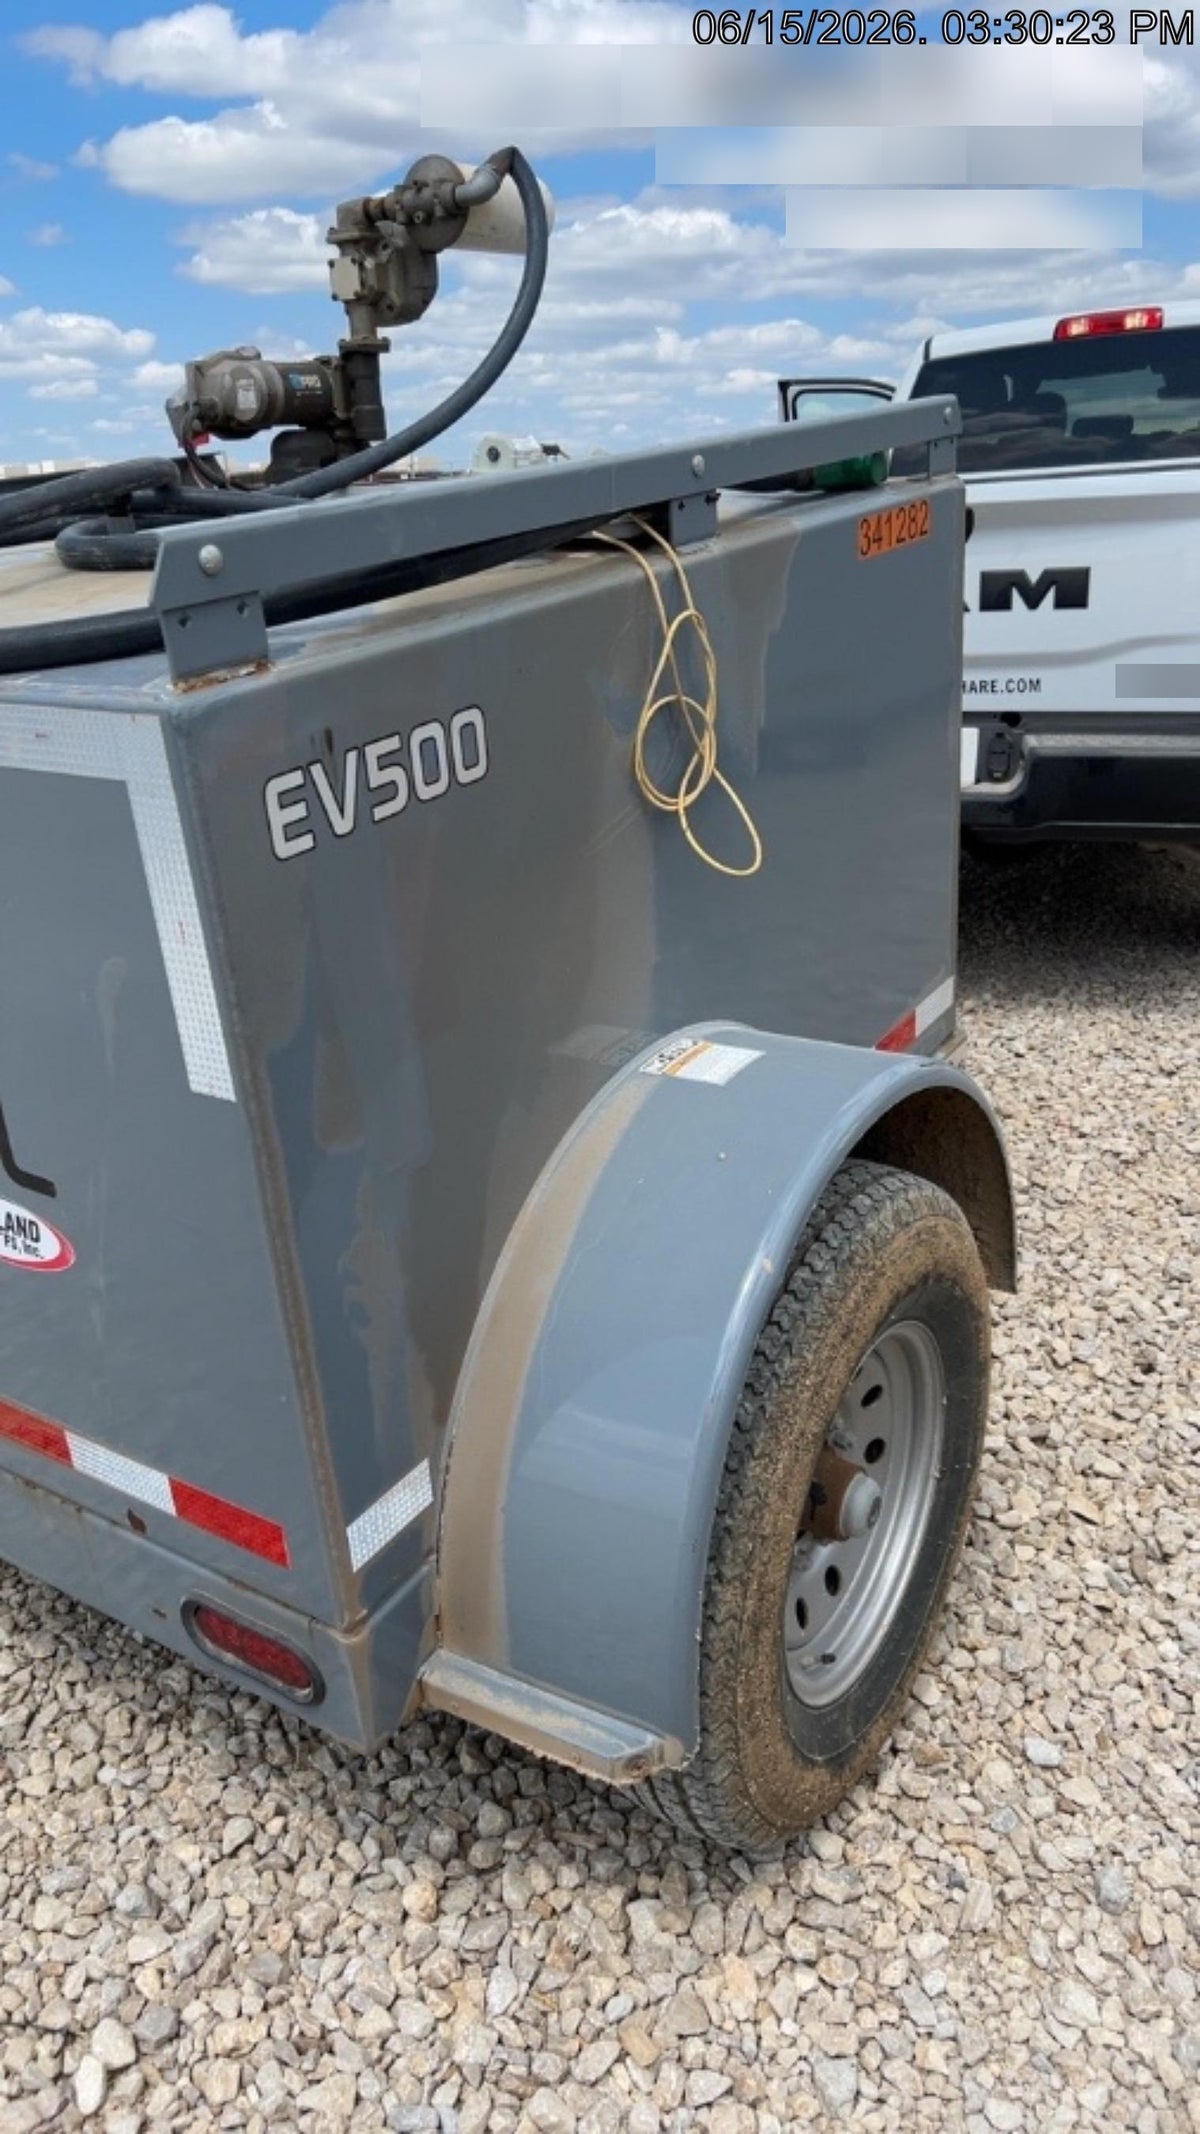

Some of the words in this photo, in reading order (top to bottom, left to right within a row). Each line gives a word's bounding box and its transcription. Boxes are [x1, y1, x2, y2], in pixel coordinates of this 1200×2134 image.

[860, 500, 929, 555] 341282
[963, 567, 1091, 612] M
[264, 704, 489, 861] EV500
